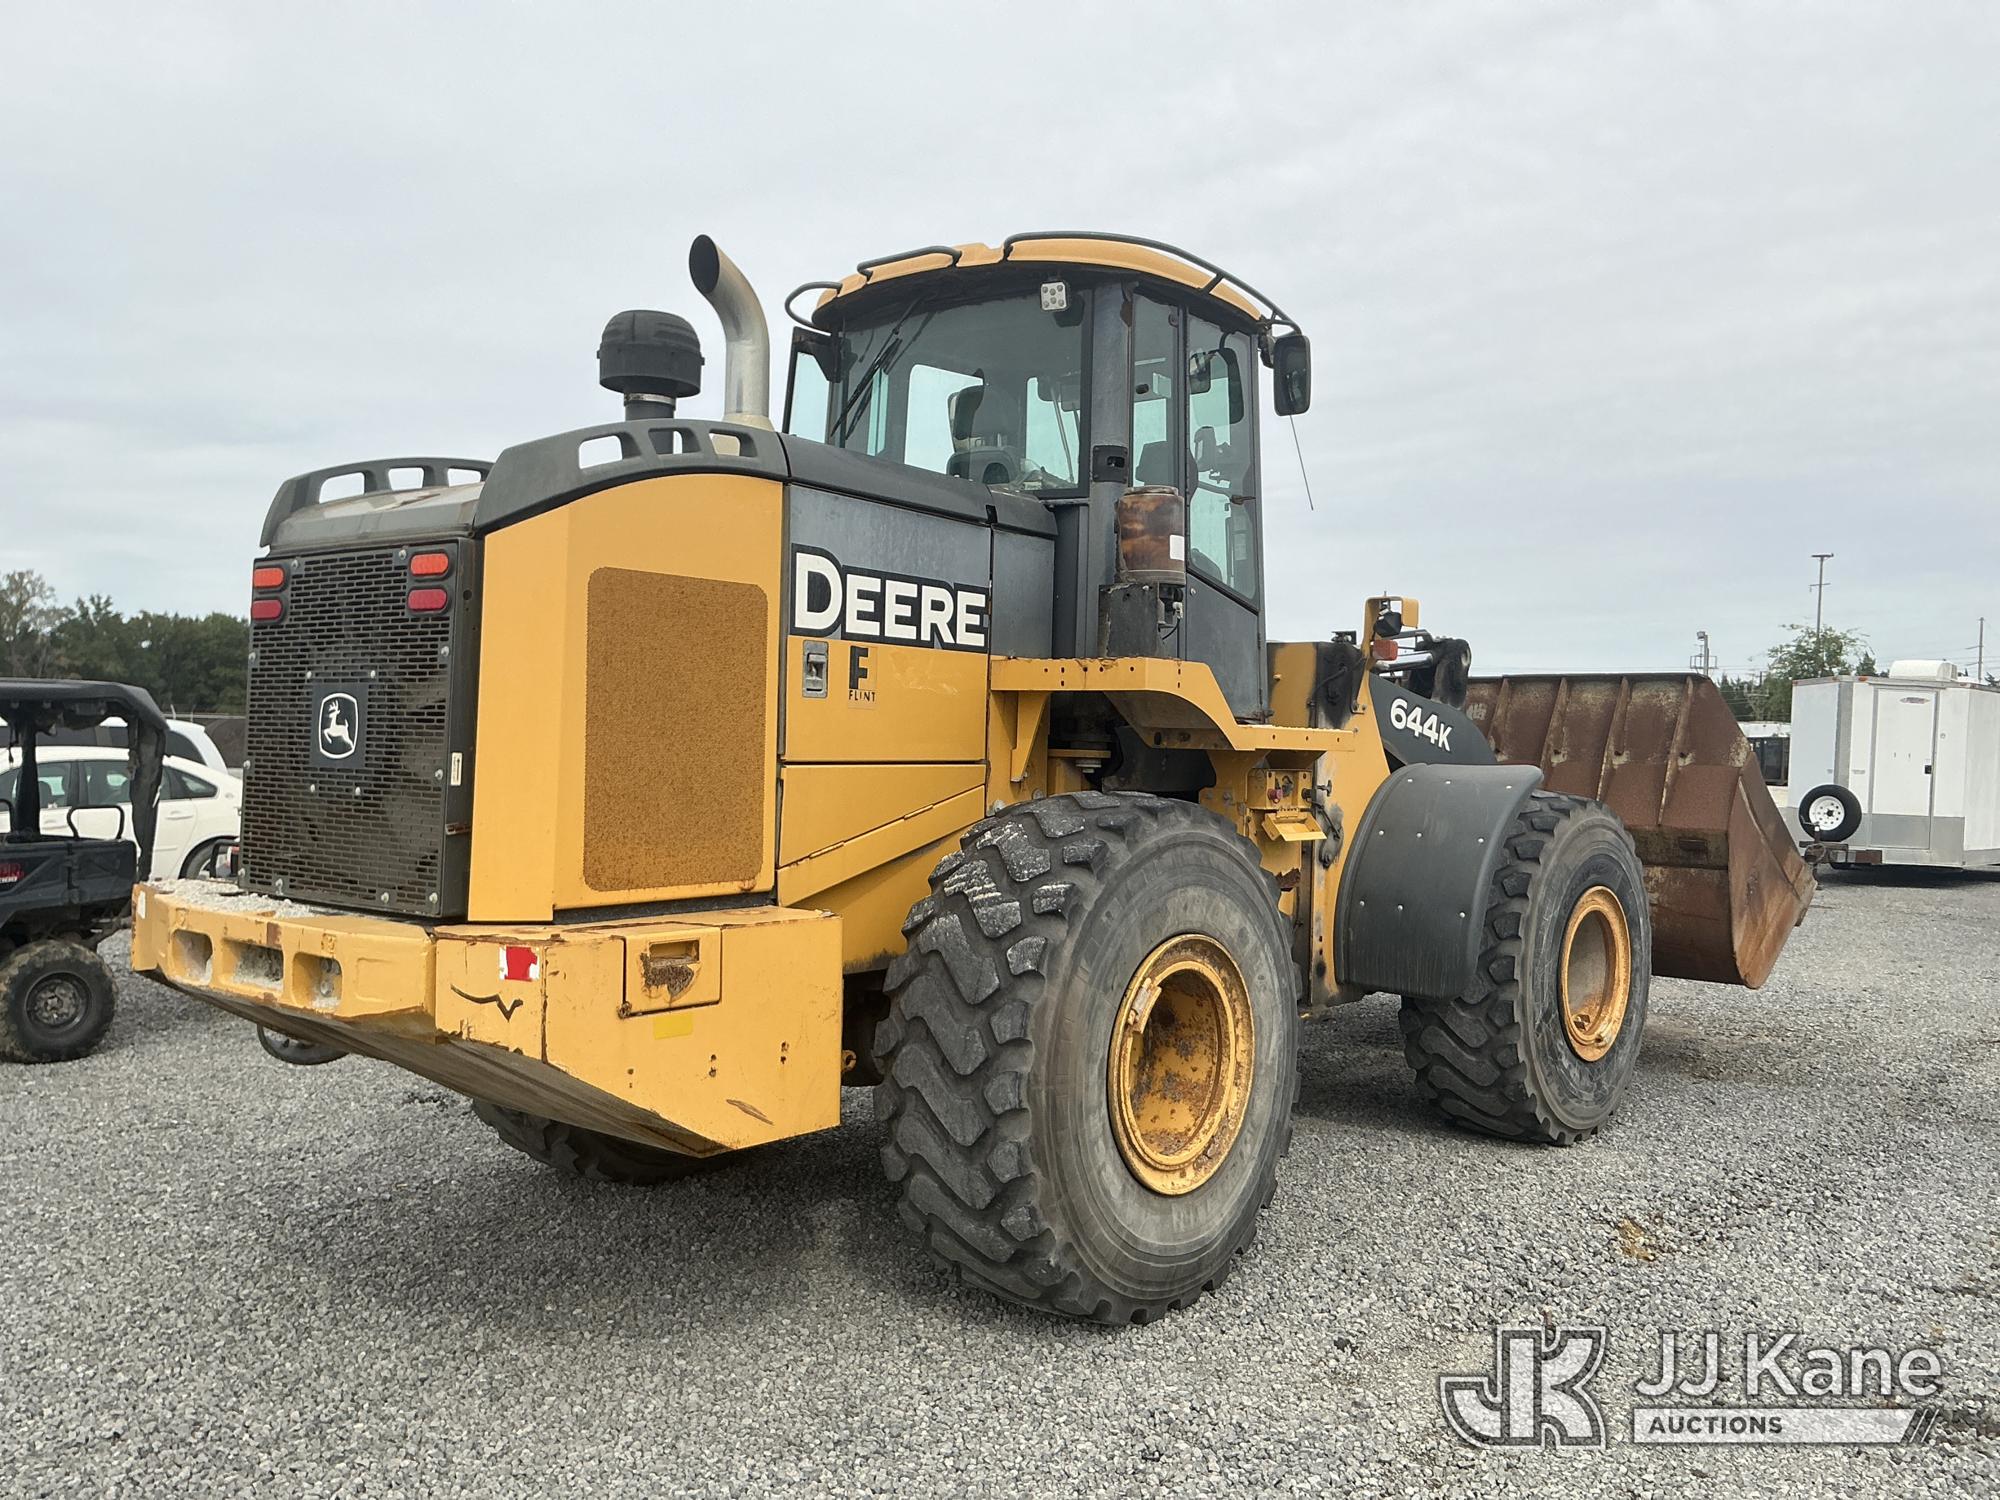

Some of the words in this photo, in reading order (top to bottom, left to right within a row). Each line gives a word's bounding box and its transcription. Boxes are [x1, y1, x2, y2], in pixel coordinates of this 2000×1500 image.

[795, 552, 986, 647] DEERE
[849, 646, 869, 689] F
[848, 690, 875, 702] FLINT
[1390, 698, 1452, 752] 644K
